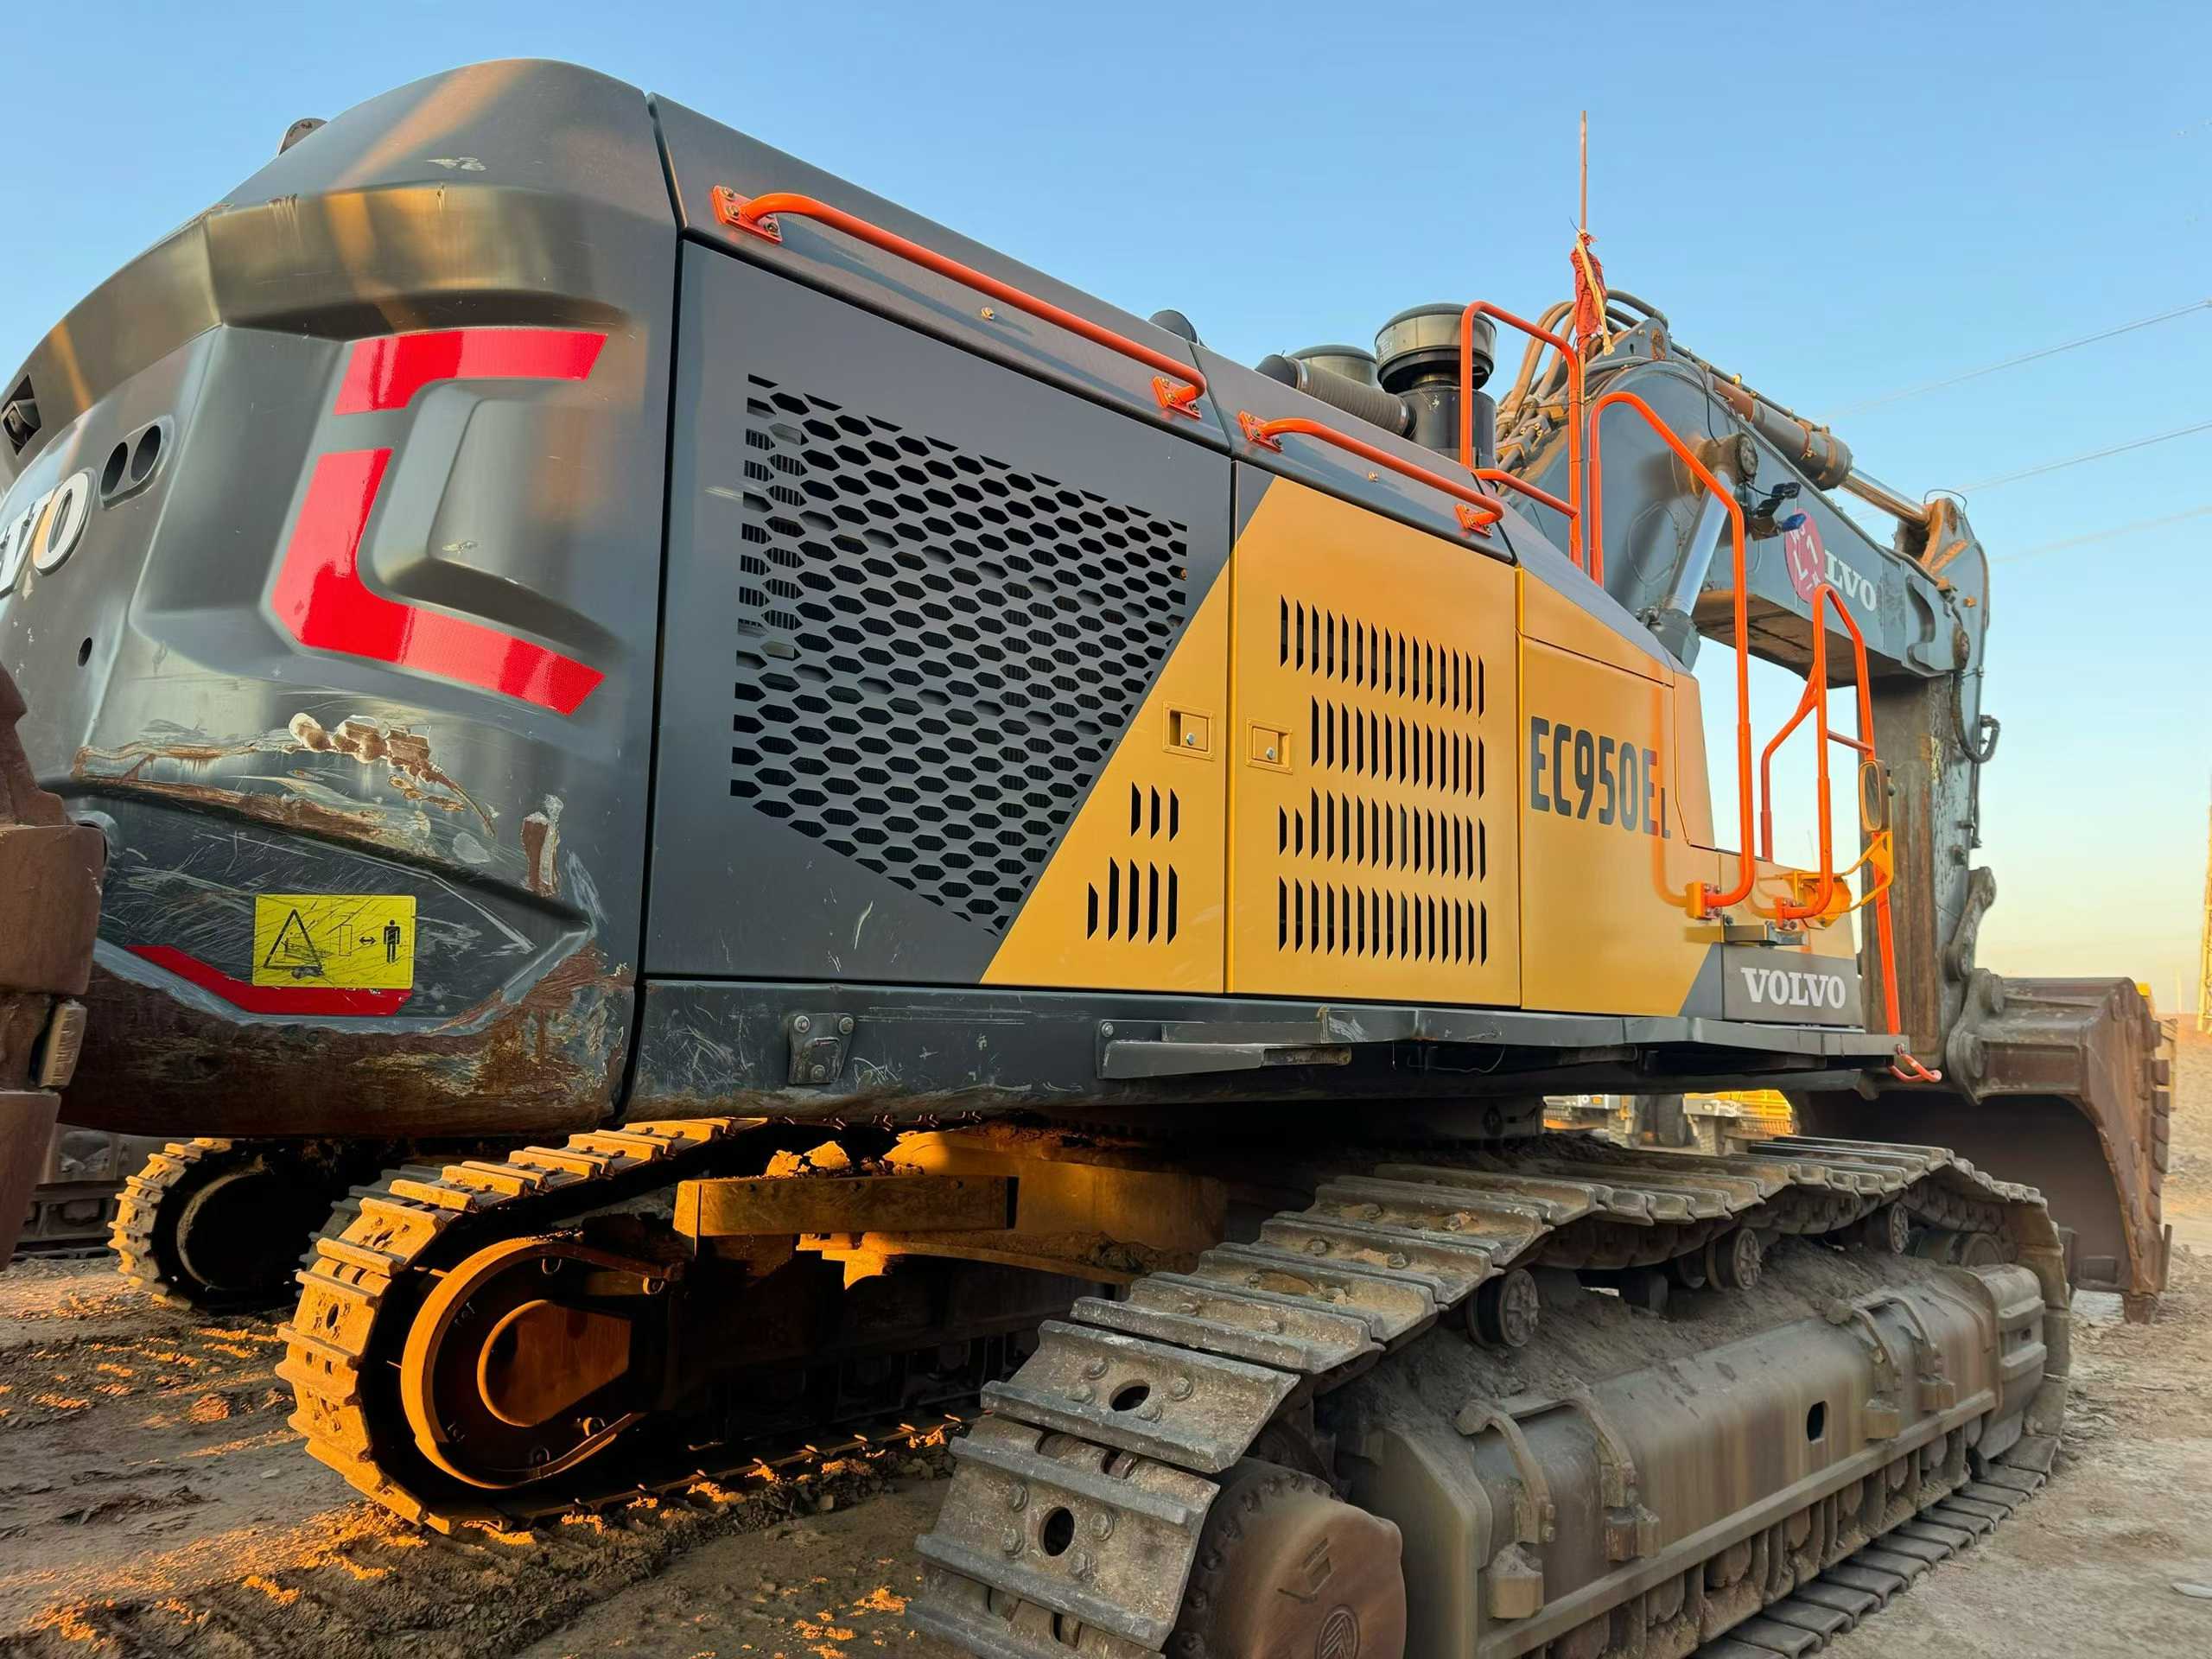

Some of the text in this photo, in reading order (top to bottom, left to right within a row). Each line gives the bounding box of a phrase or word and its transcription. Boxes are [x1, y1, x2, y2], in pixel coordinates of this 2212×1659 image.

[0, 473, 91, 594] VO
[1825, 550, 1877, 611] LVO
[1531, 715, 1671, 840] EC950EL
[1740, 967, 1847, 1009] VOLVO
